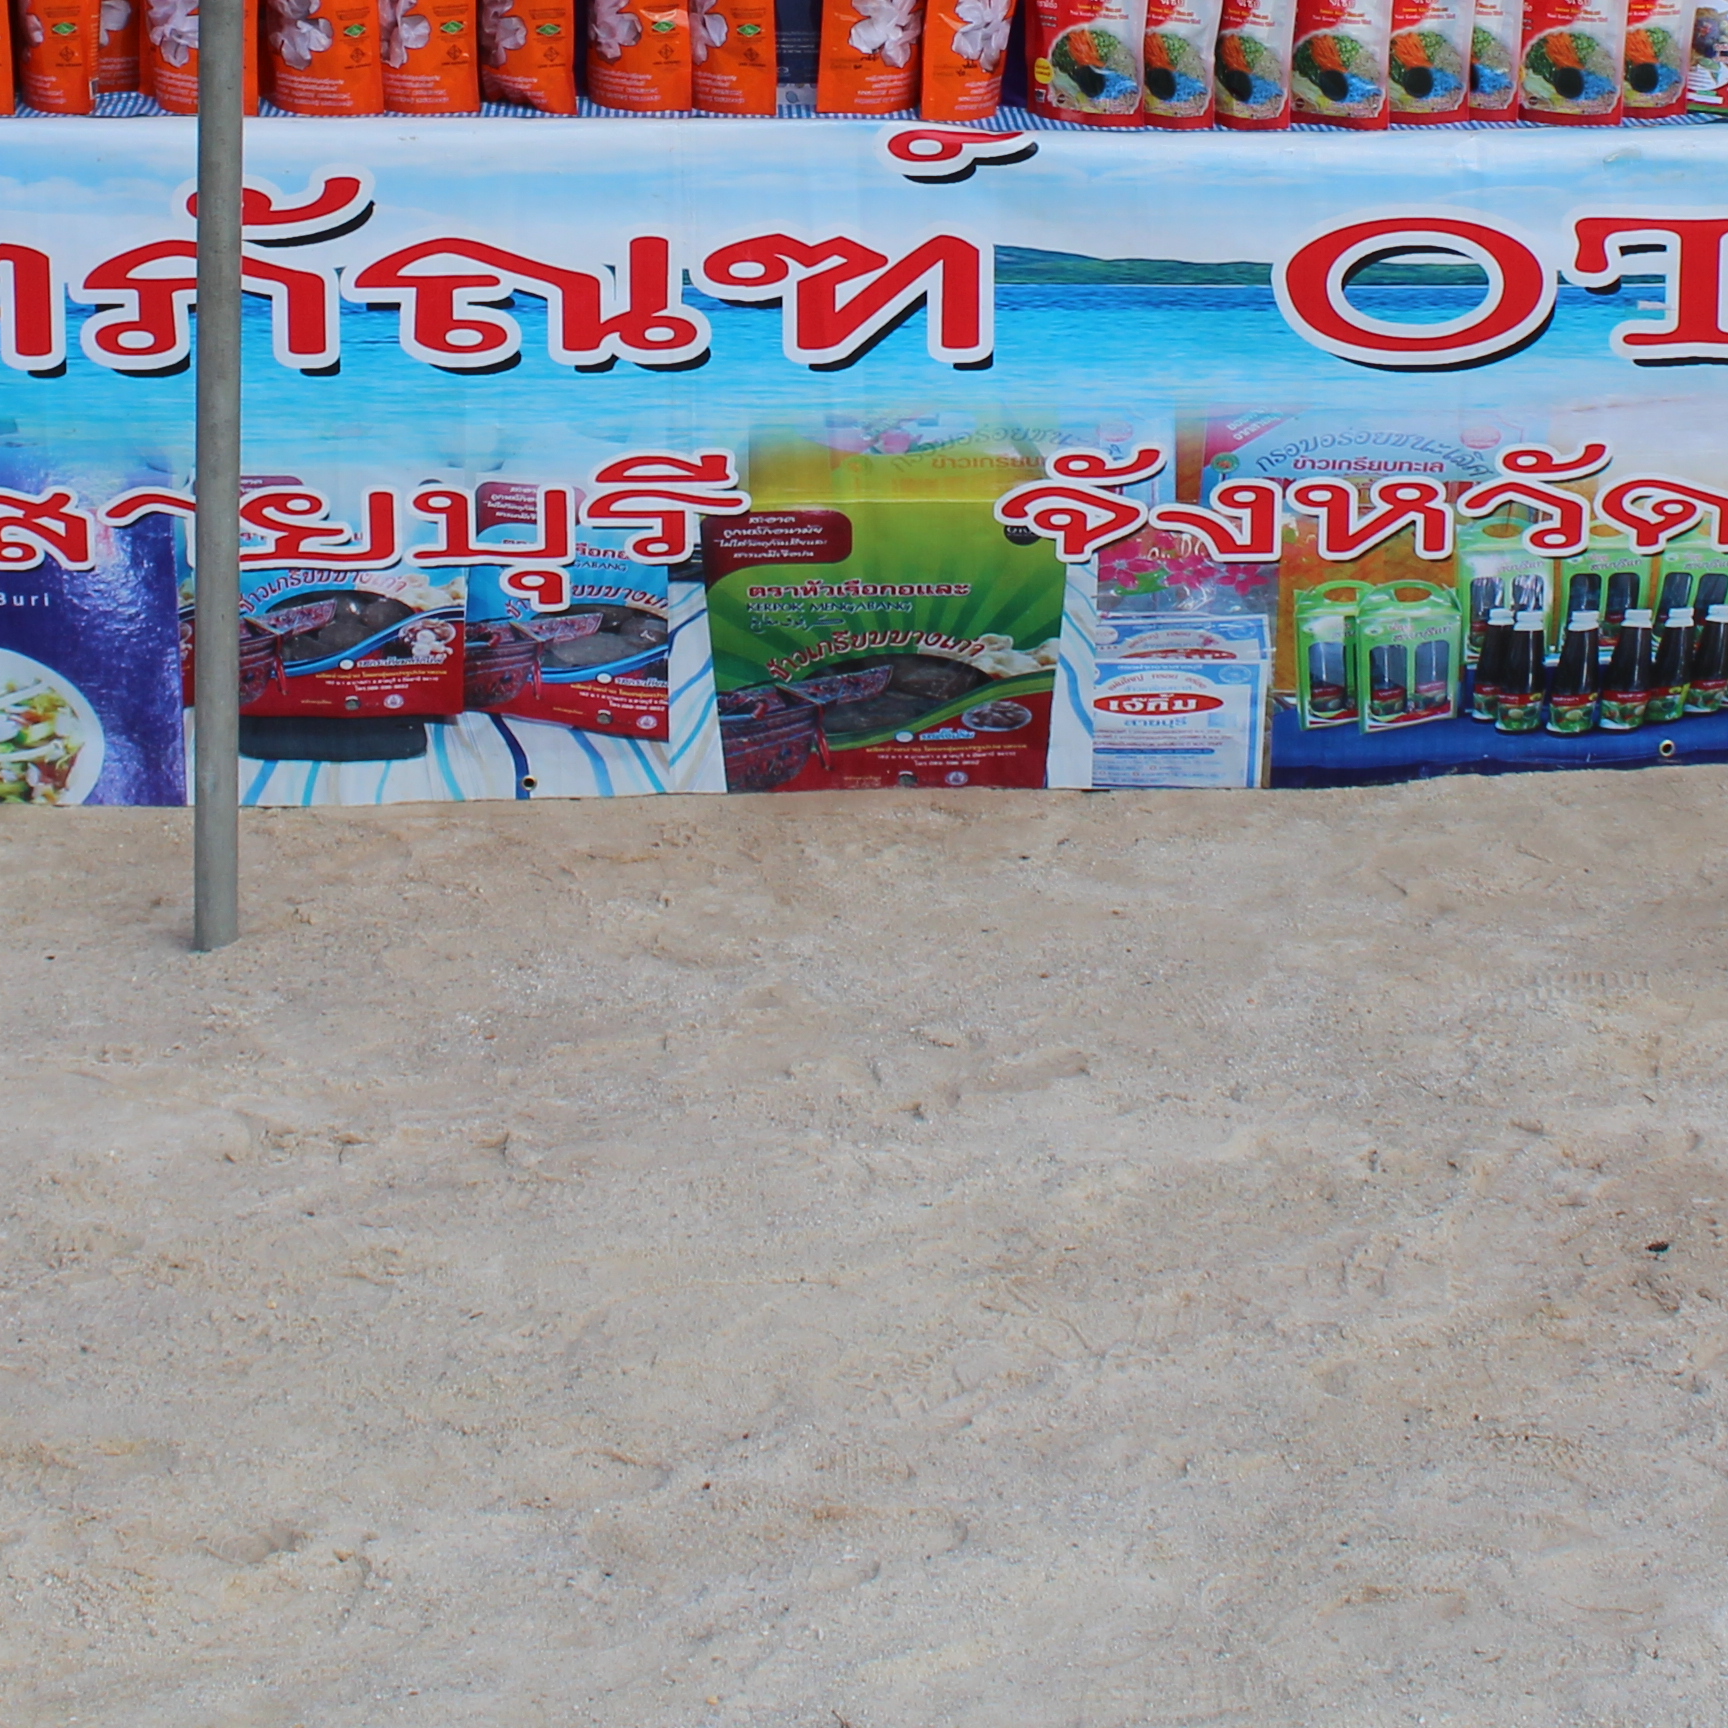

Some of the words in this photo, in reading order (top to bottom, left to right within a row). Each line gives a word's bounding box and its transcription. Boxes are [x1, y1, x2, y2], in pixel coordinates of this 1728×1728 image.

[1292, 455, 1445, 474] ข้าวเกรียบทะเล
[571, 559, 628, 572] GABANG
[747, 578, 972, 599] ตราหัวเรือกอและ
